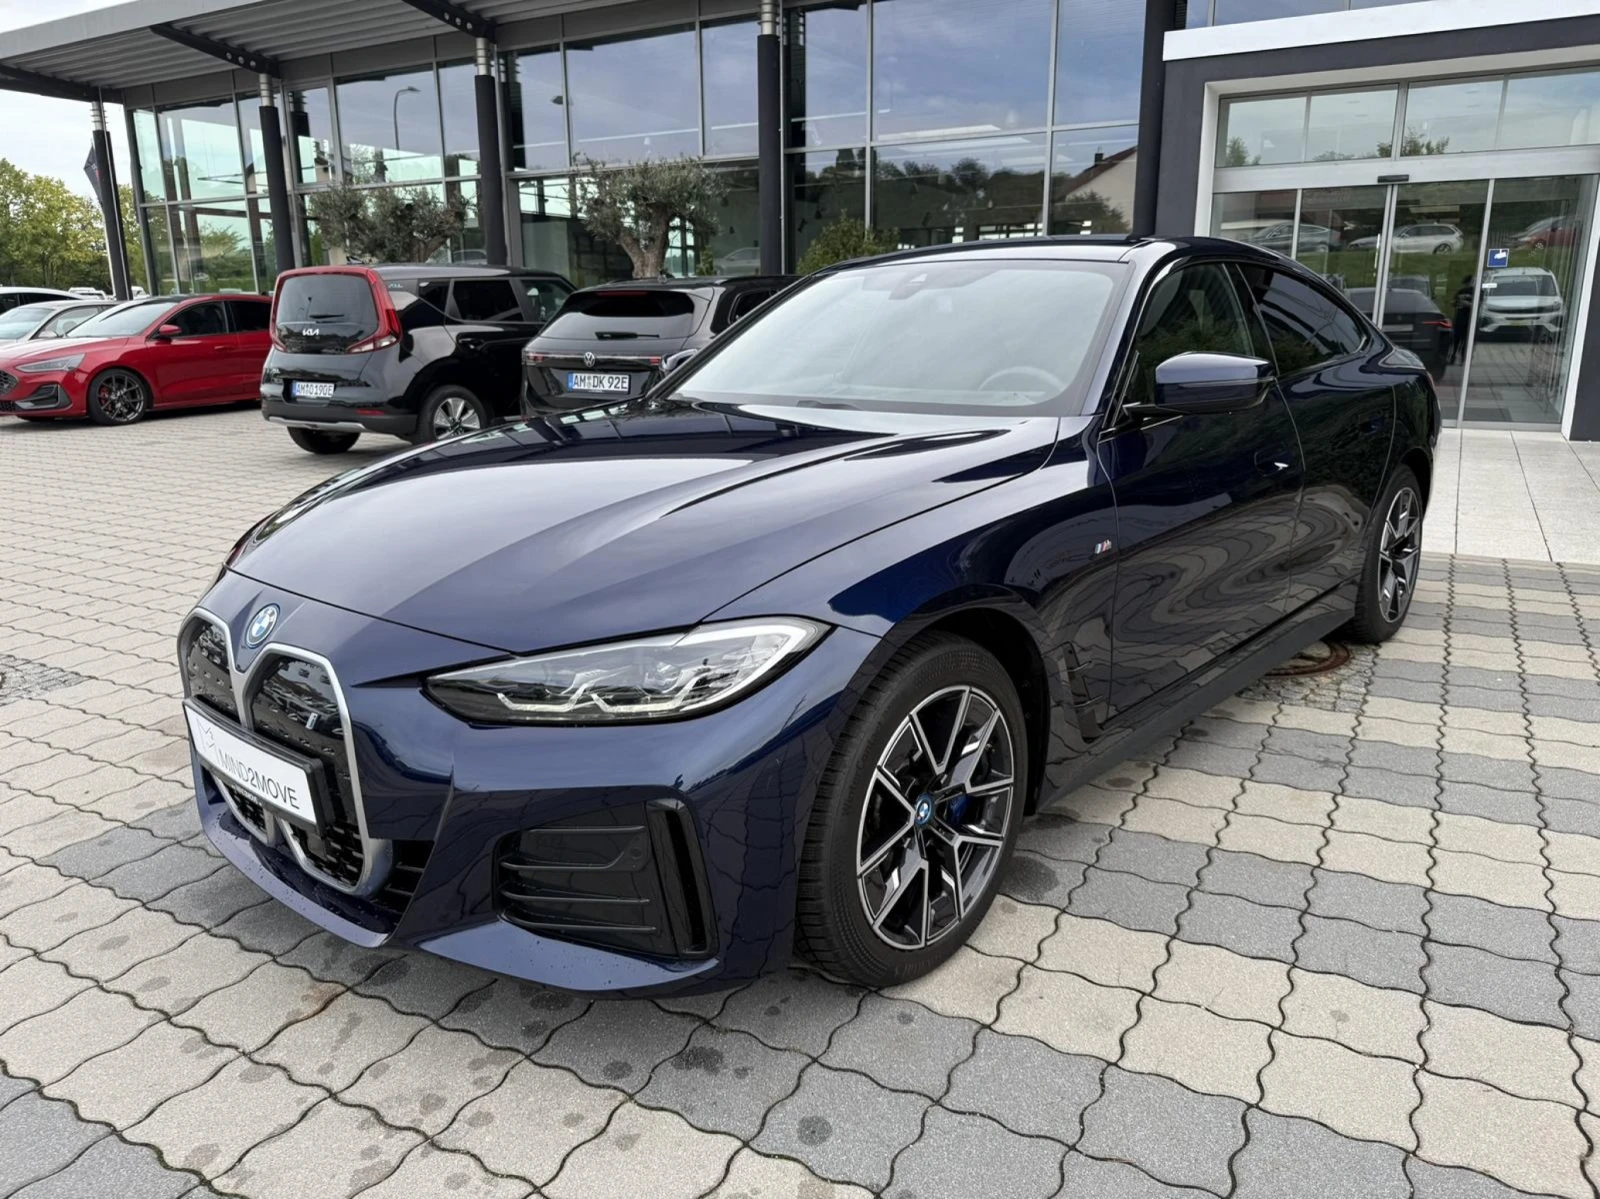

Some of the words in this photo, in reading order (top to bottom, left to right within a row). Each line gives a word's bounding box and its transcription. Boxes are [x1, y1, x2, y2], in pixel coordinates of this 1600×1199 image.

[573, 374, 586, 388] AM
[592, 375, 606, 389] DK
[607, 376, 629, 390] 92E
[218, 748, 300, 810] MIND2MOVE
